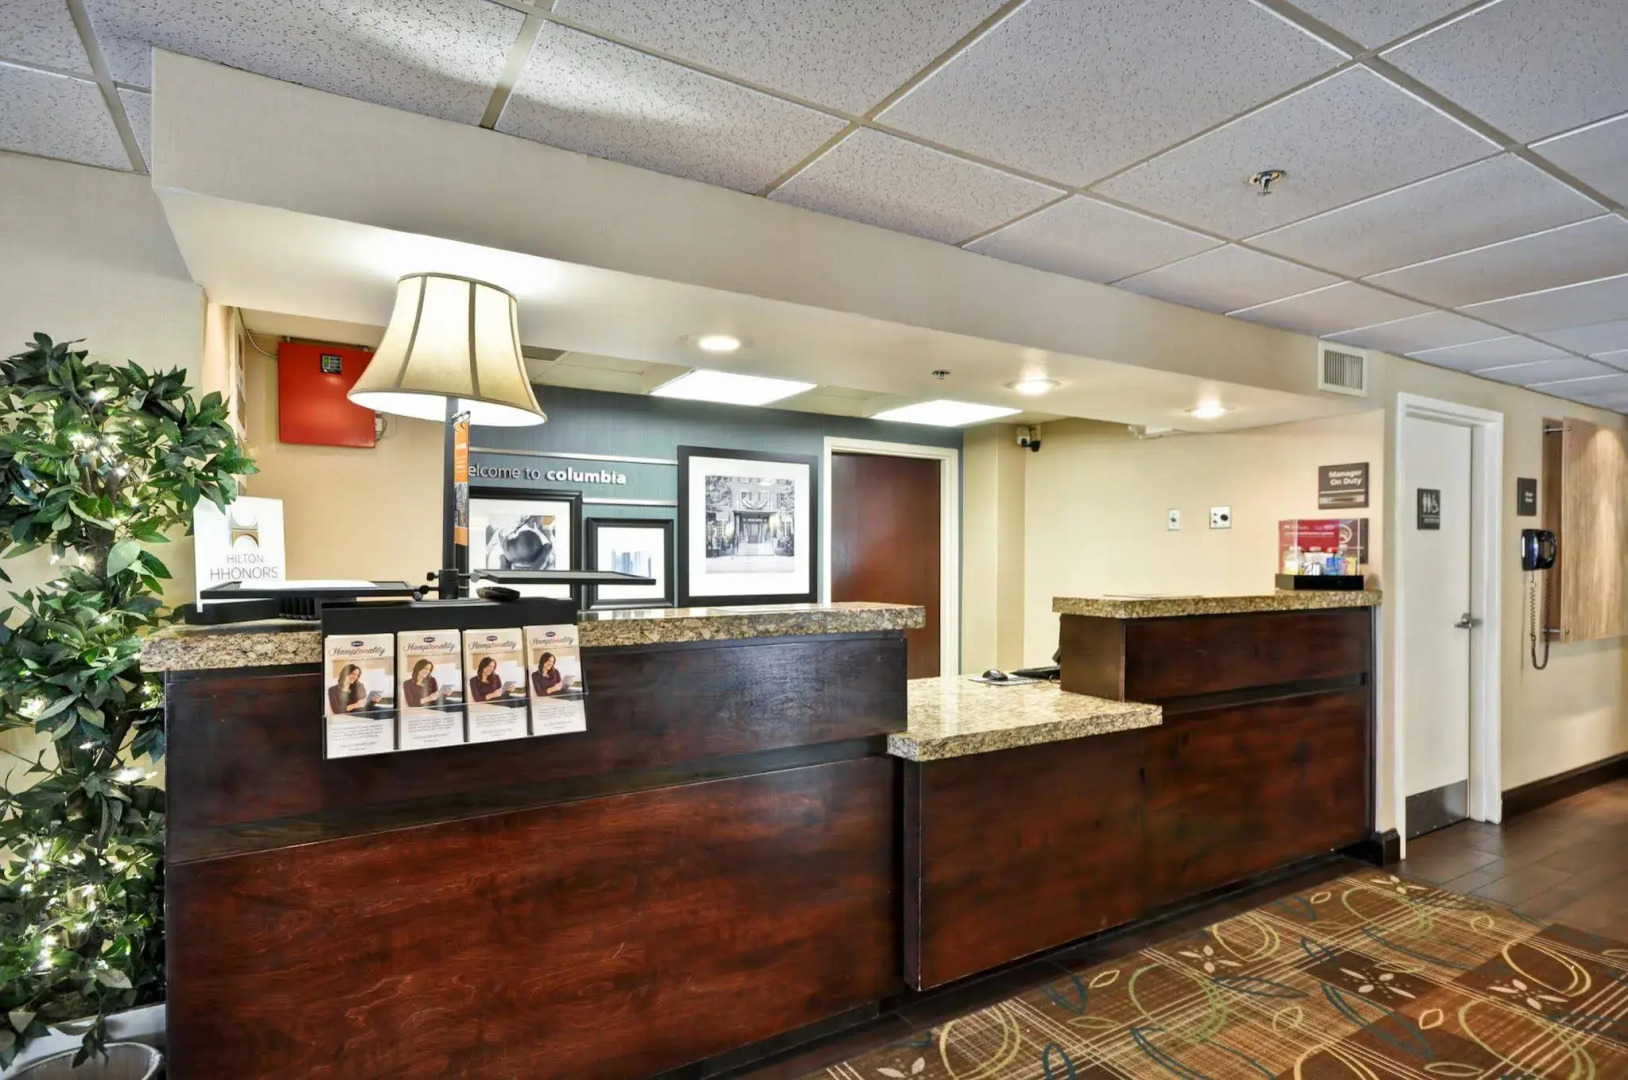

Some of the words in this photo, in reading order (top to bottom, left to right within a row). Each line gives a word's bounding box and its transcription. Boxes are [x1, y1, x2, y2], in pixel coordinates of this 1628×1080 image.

[468, 462, 520, 479] elcome
[525, 467, 541, 480] to
[547, 467, 627, 485] columbia
[1328, 470, 1362, 479] Manager
[1330, 478, 1342, 486] On
[1343, 477, 1362, 486] Duty
[226, 553, 264, 564] HILTON
[210, 565, 278, 580] HHONORS
